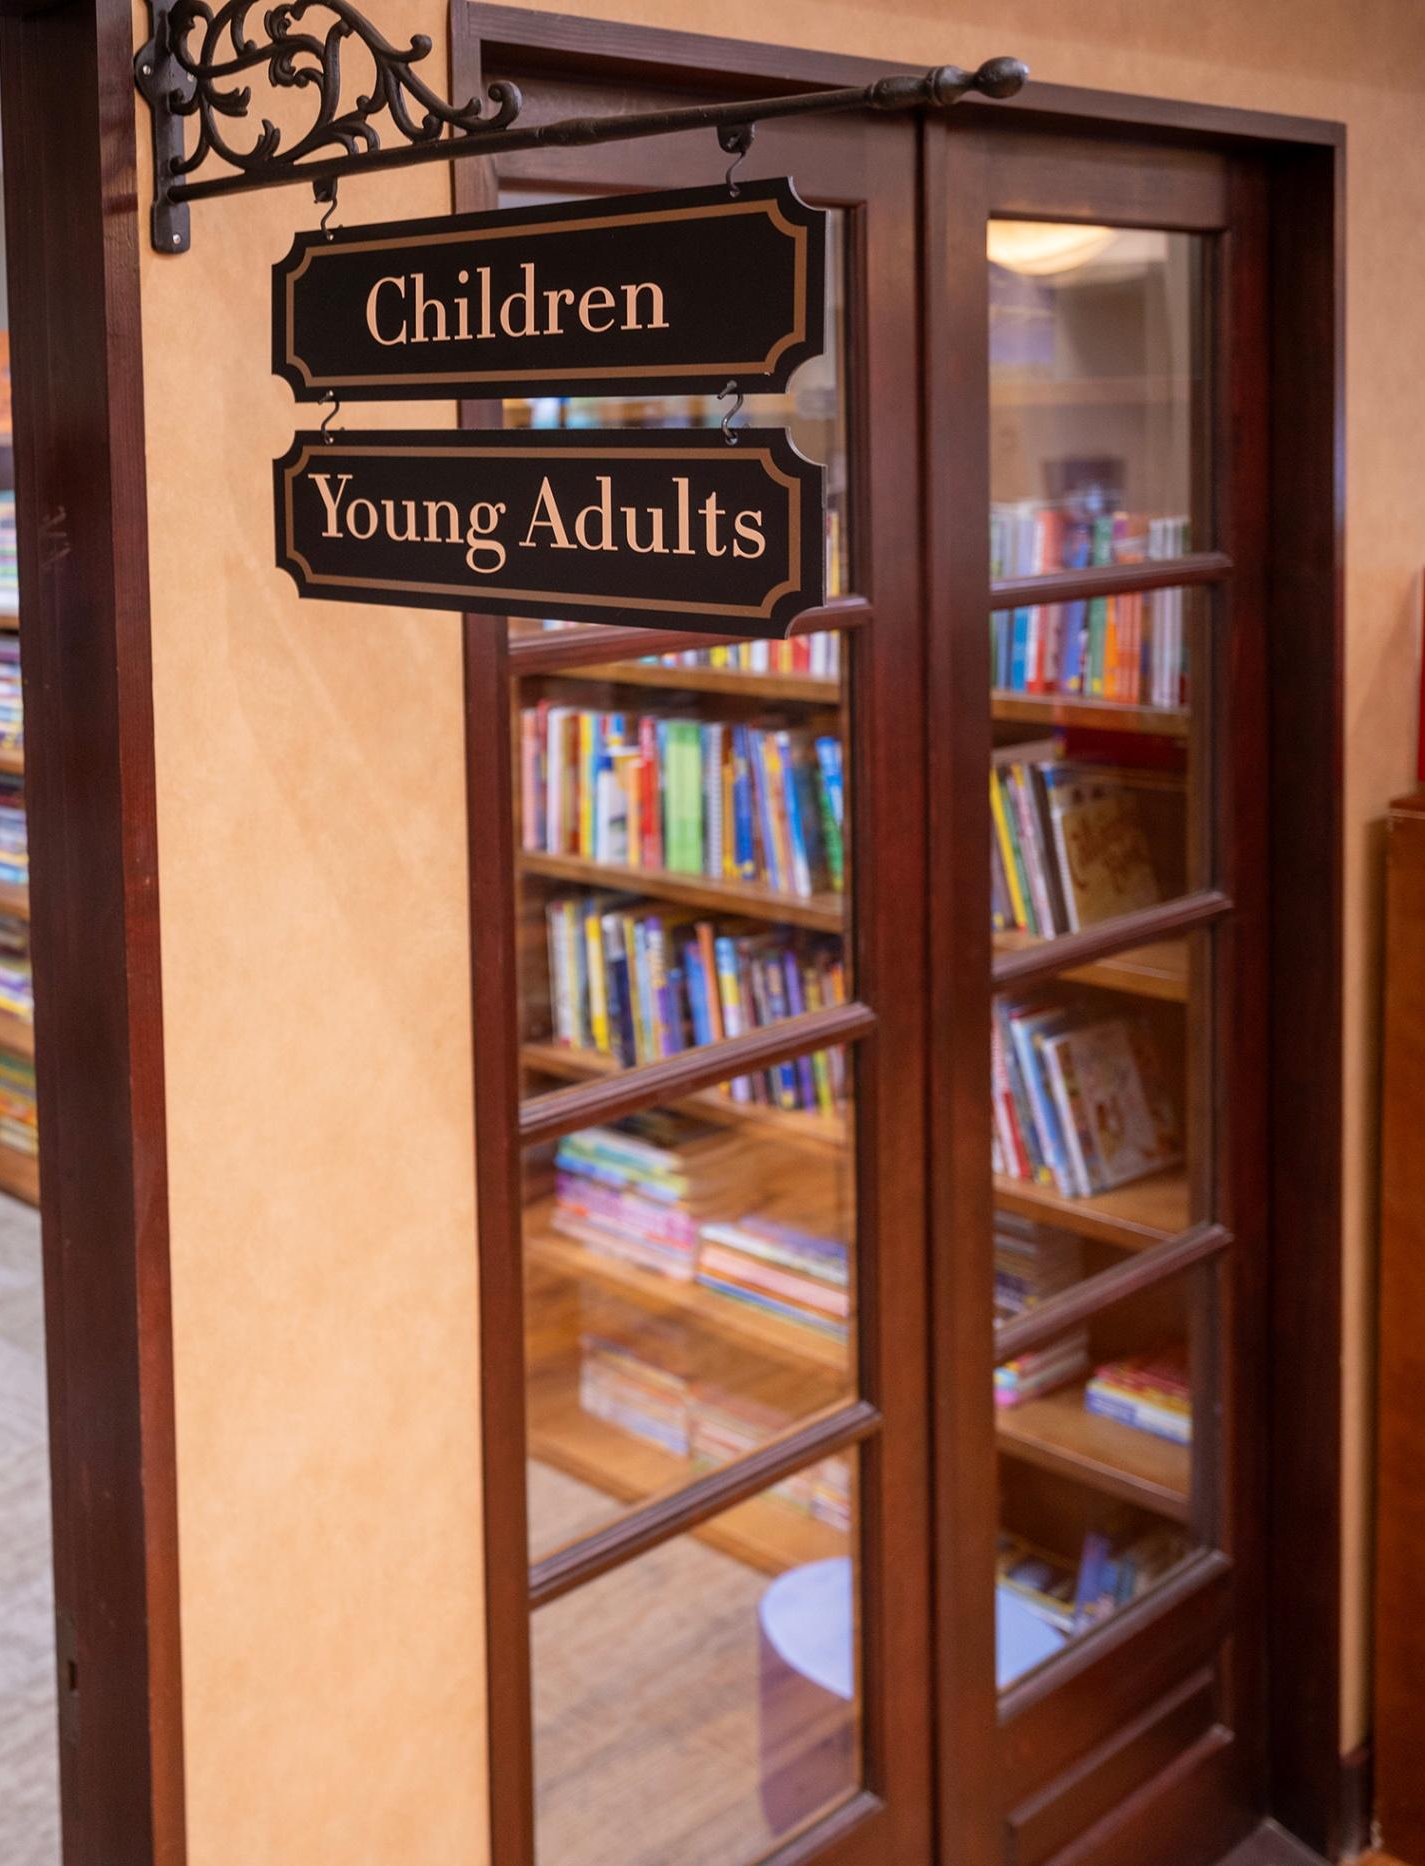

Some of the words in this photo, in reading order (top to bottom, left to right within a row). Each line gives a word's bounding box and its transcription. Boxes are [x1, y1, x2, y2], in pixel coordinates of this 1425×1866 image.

[366, 262, 670, 346] Children
[308, 473, 506, 574] Young
[518, 475, 767, 559] Adults
